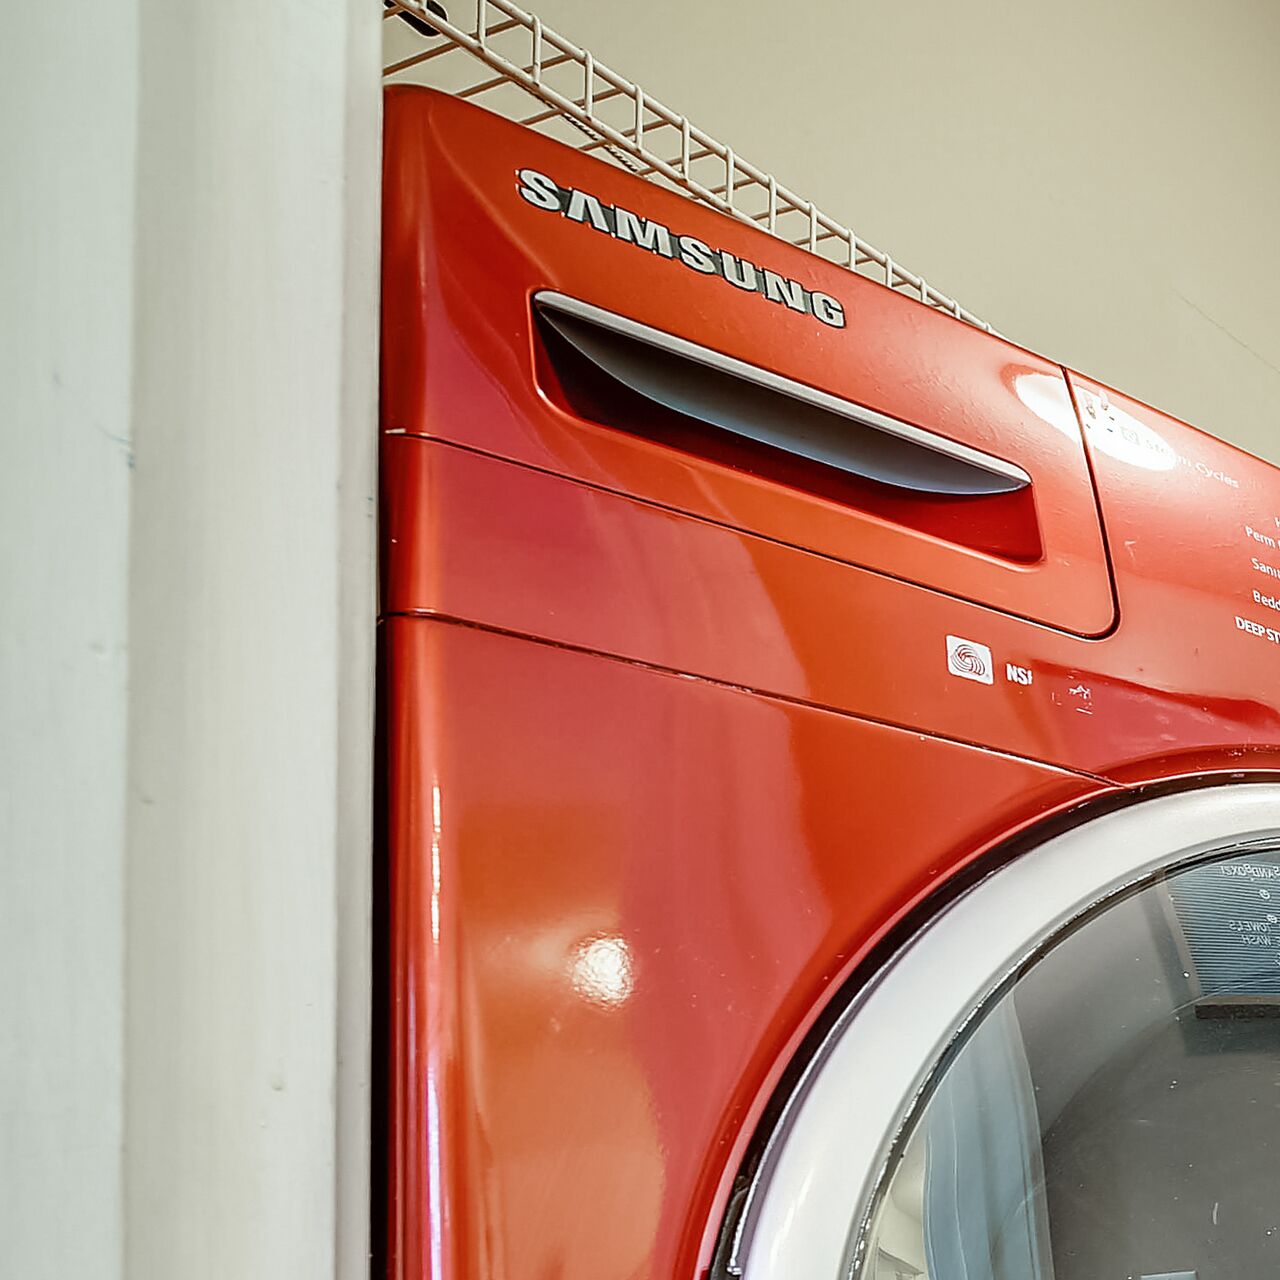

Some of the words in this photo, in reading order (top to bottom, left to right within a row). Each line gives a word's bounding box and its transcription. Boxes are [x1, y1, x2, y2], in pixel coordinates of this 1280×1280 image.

[516, 167, 846, 329] SAMSUNG
[1195, 462, 1239, 488] Cycles
[1245, 526, 1276, 548] Perm
[1235, 616, 1266, 637] DEEP
